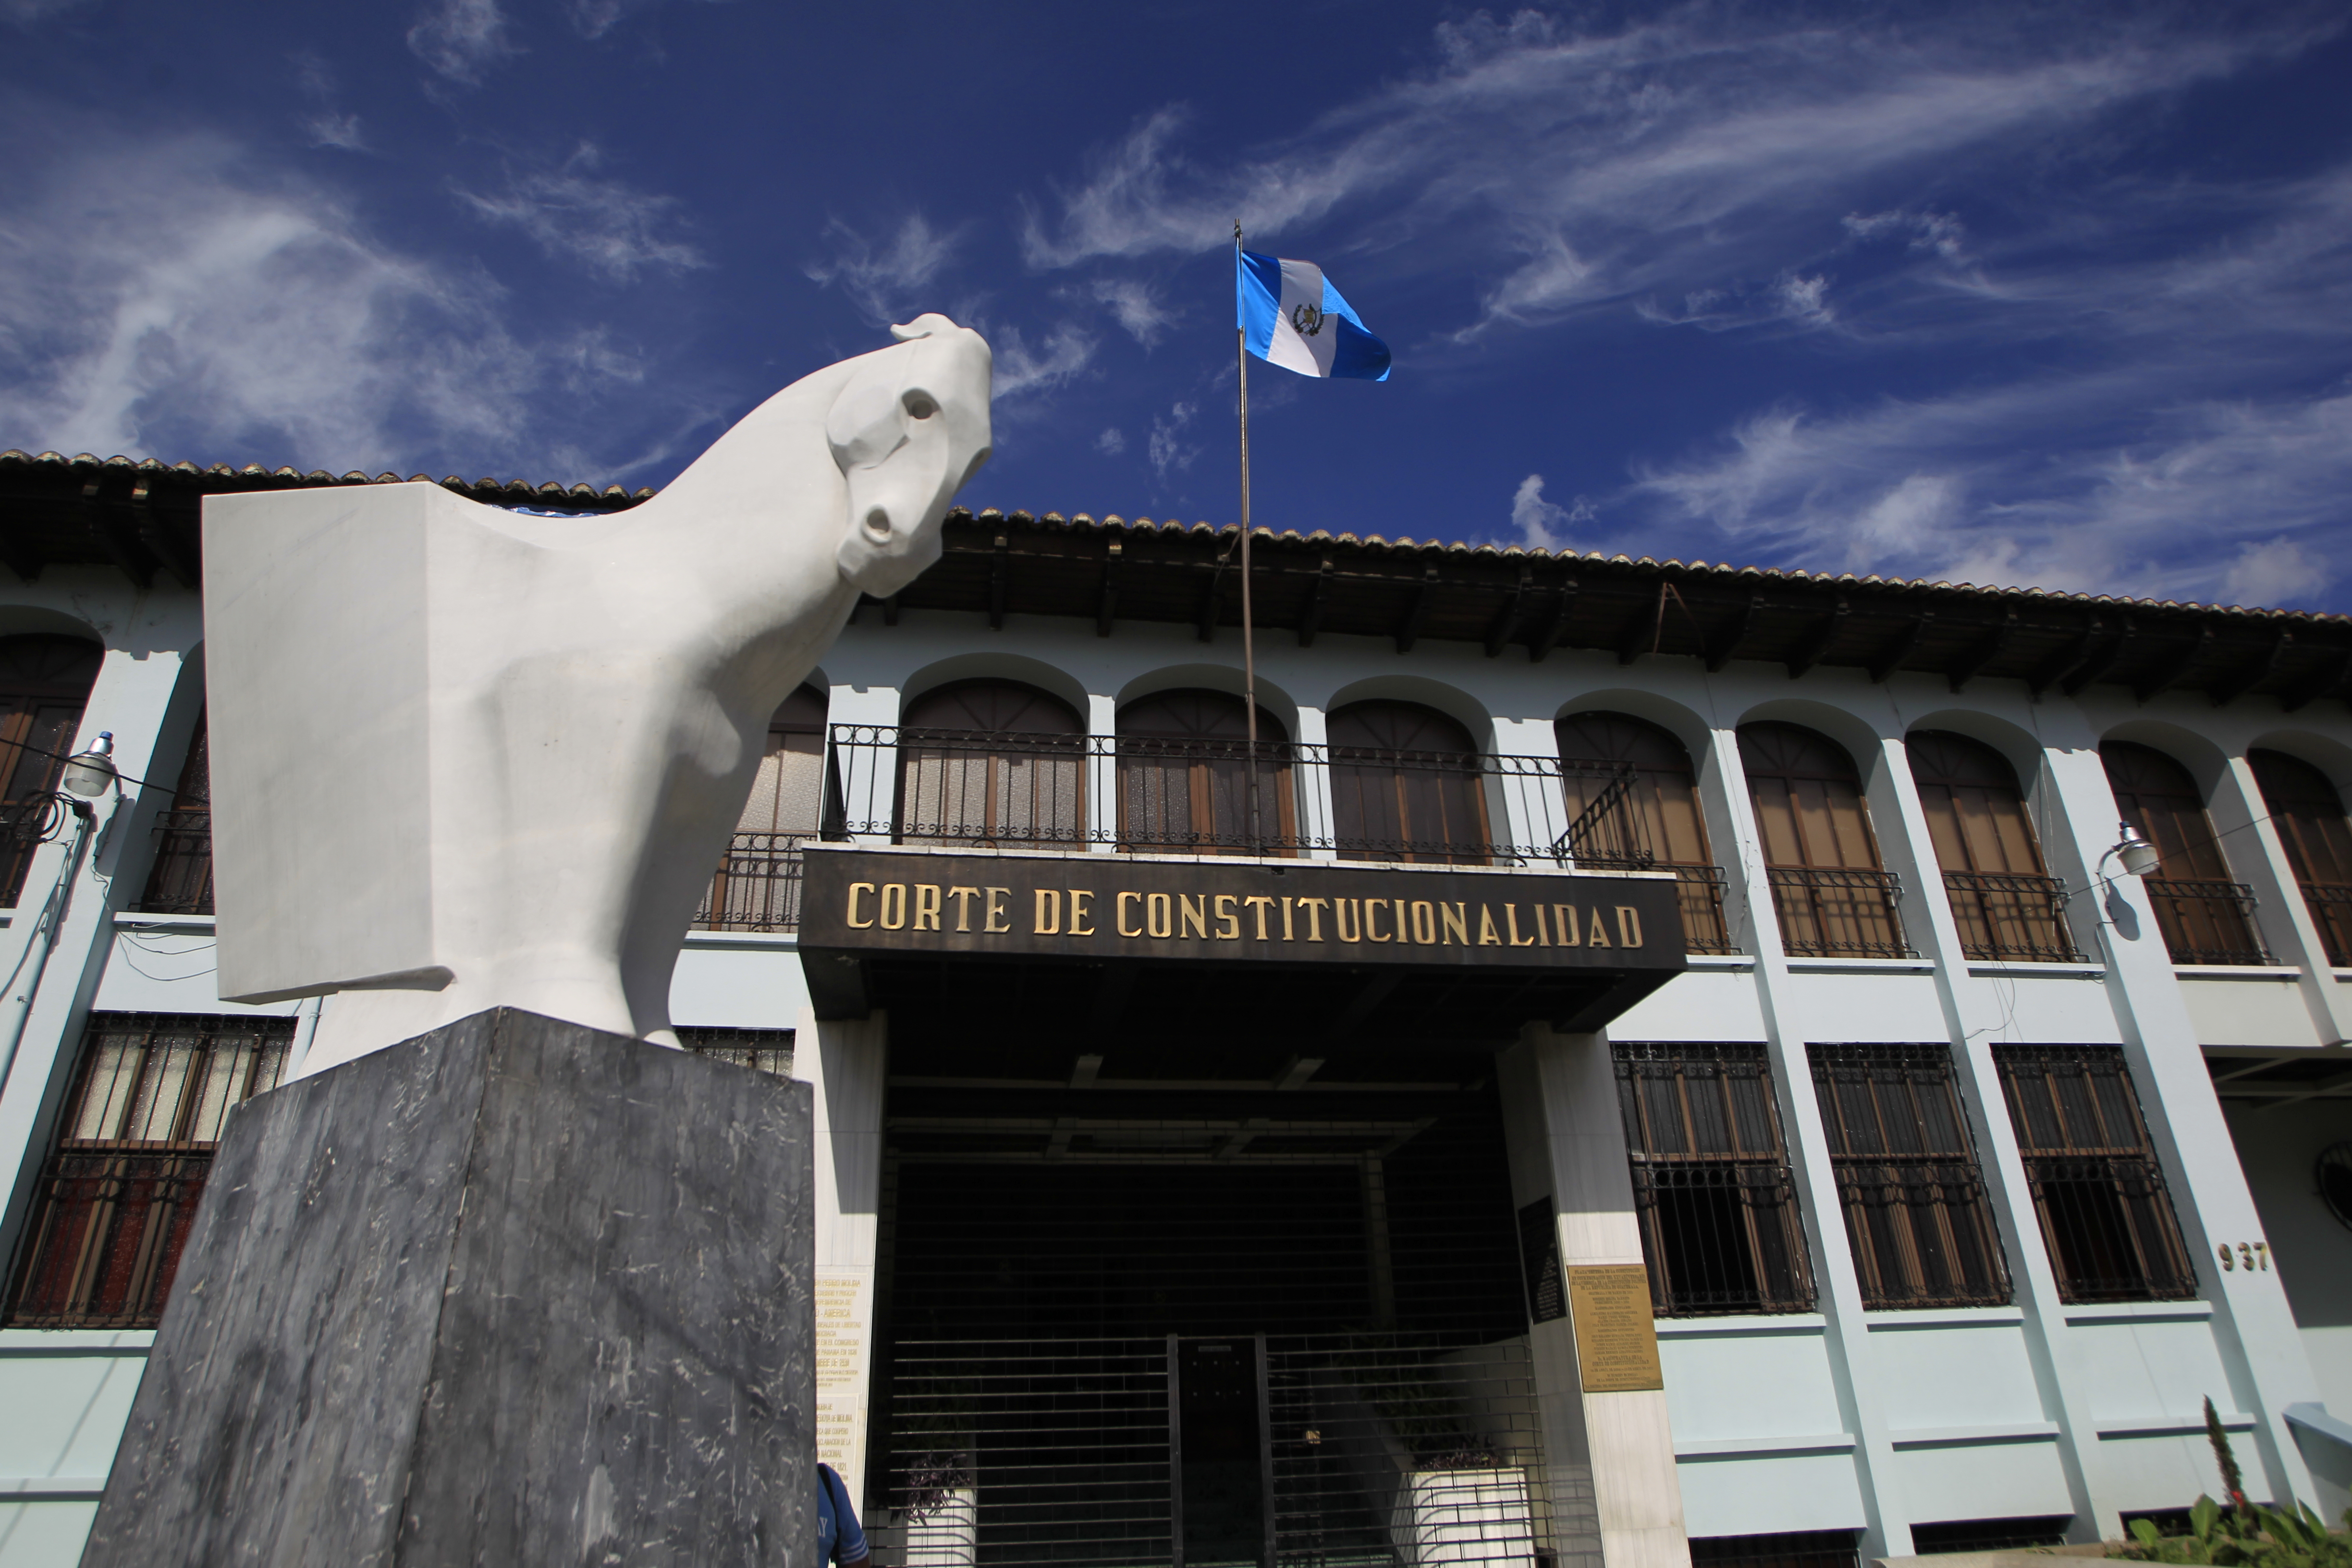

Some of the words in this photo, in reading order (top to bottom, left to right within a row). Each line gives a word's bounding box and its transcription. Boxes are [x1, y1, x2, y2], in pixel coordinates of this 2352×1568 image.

[847, 882, 1011, 933] CORTE
[1033, 888, 1095, 936] DE
[1116, 892, 1642, 948] CONSTITUCIONALIDAD
[2218, 1241, 2267, 1271] 937
